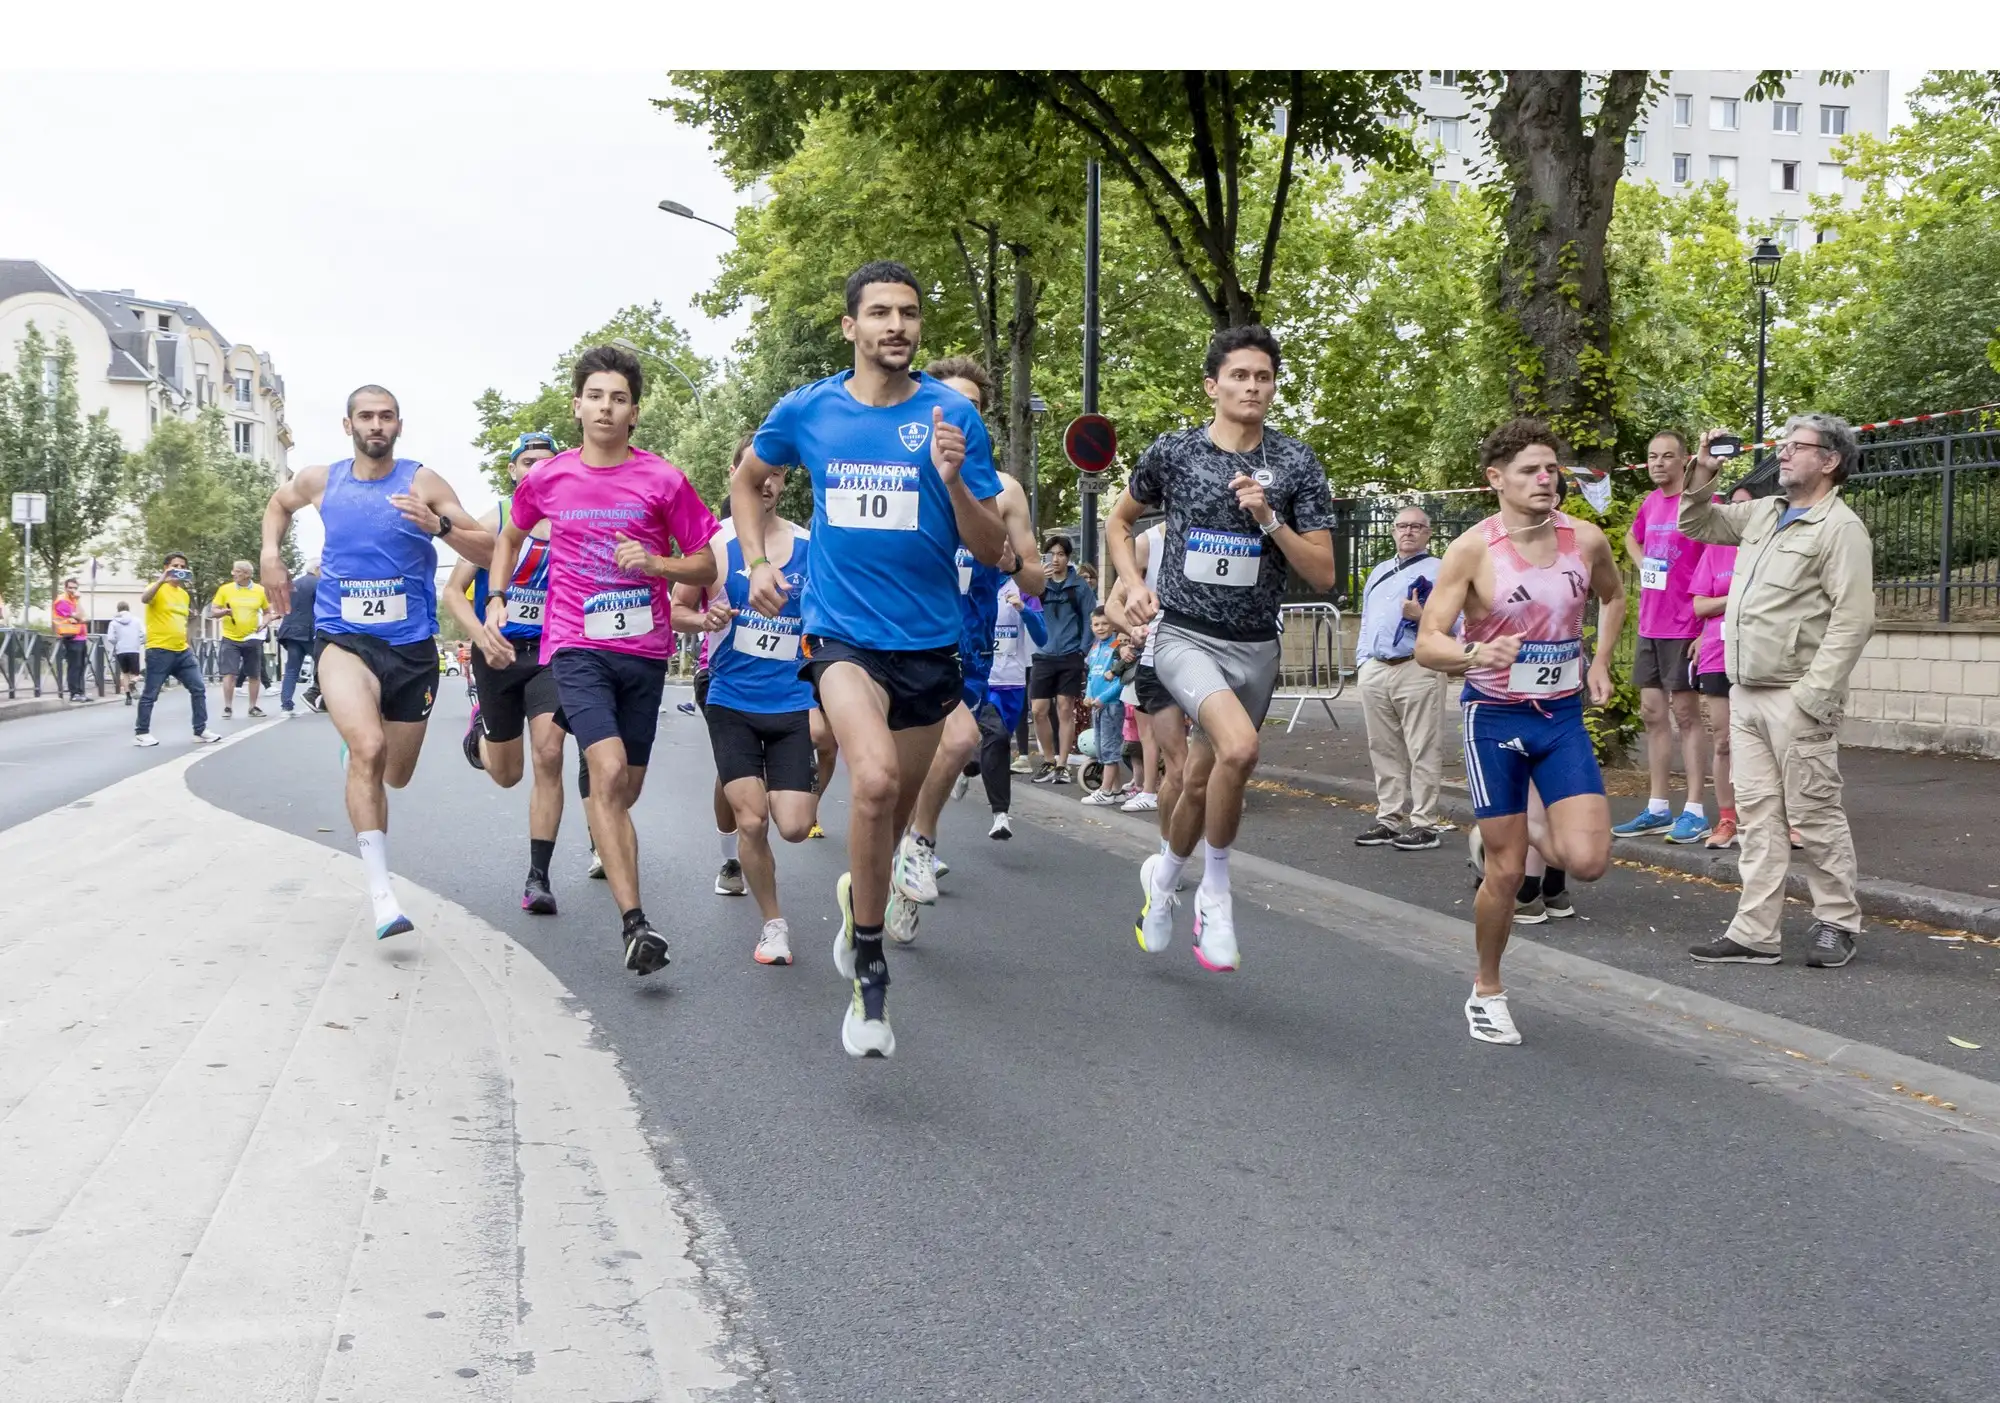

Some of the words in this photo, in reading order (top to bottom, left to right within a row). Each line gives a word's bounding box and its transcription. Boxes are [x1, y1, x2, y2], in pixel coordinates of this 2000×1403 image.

[827, 463, 839, 474] LA
[839, 463, 919, 478] FONTENAISIENNE
[856, 494, 888, 518] 10
[560, 510, 570, 520] LA
[571, 509, 645, 520] FONTENAISIENNE
[1190, 531, 1199, 540] LA
[1200, 532, 1261, 546] FONTENAISIENNE
[1215, 558, 1230, 577] 8
[340, 580, 348, 588] LA
[349, 576, 405, 588] FONTENAISIENNE
[362, 600, 386, 617] 24
[518, 604, 540, 620] 28
[740, 609, 750, 617] LA
[614, 612, 626, 631] 3
[756, 633, 781, 652] 47
[1536, 666, 1562, 685] 29
